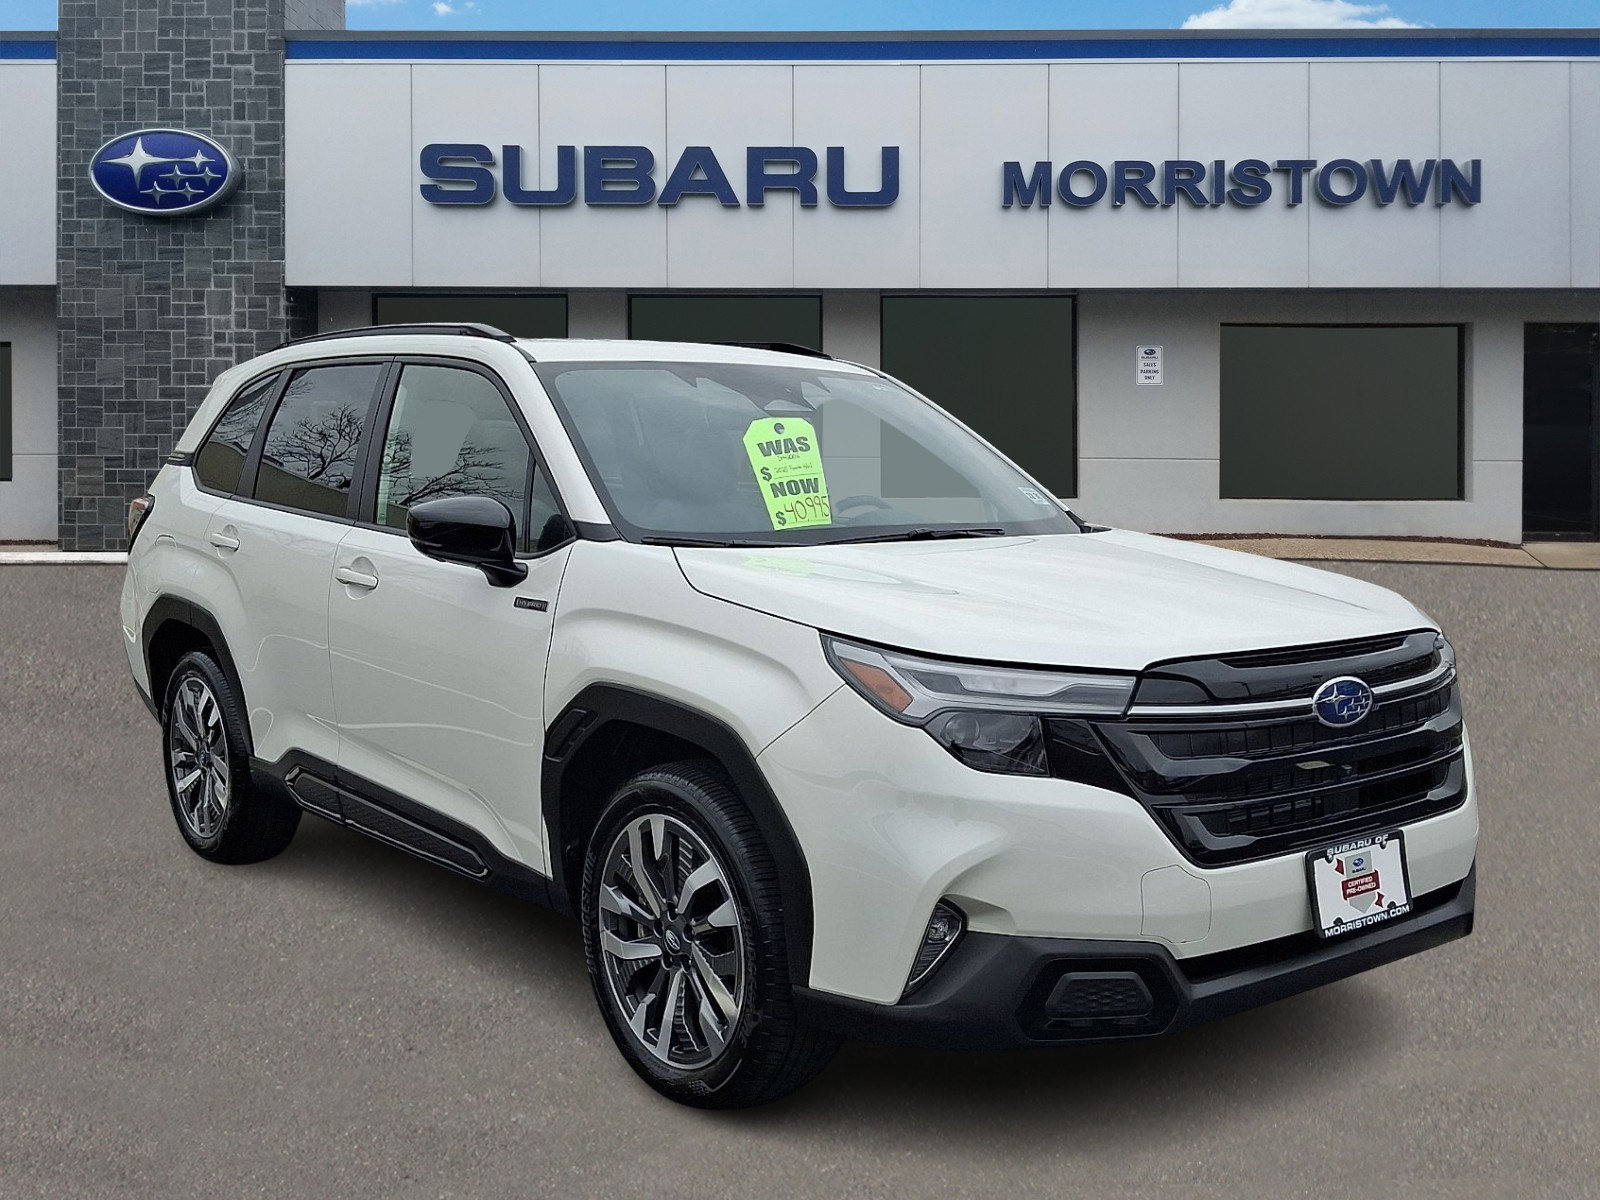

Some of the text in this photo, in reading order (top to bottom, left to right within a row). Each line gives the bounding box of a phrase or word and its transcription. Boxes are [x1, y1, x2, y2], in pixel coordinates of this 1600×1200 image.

[419, 143, 900, 207] SUBARU
[1001, 158, 1483, 208] MORRISTOWN
[757, 437, 810, 457] WAS
[770, 478, 818, 498] NOW
[1326, 834, 1389, 856] SUBARU OF
[1346, 882, 1377, 895] PRE-OWNED
[1347, 876, 1373, 888] CERTIFIED
[1324, 905, 1410, 937] MORRISTOWN.COM
